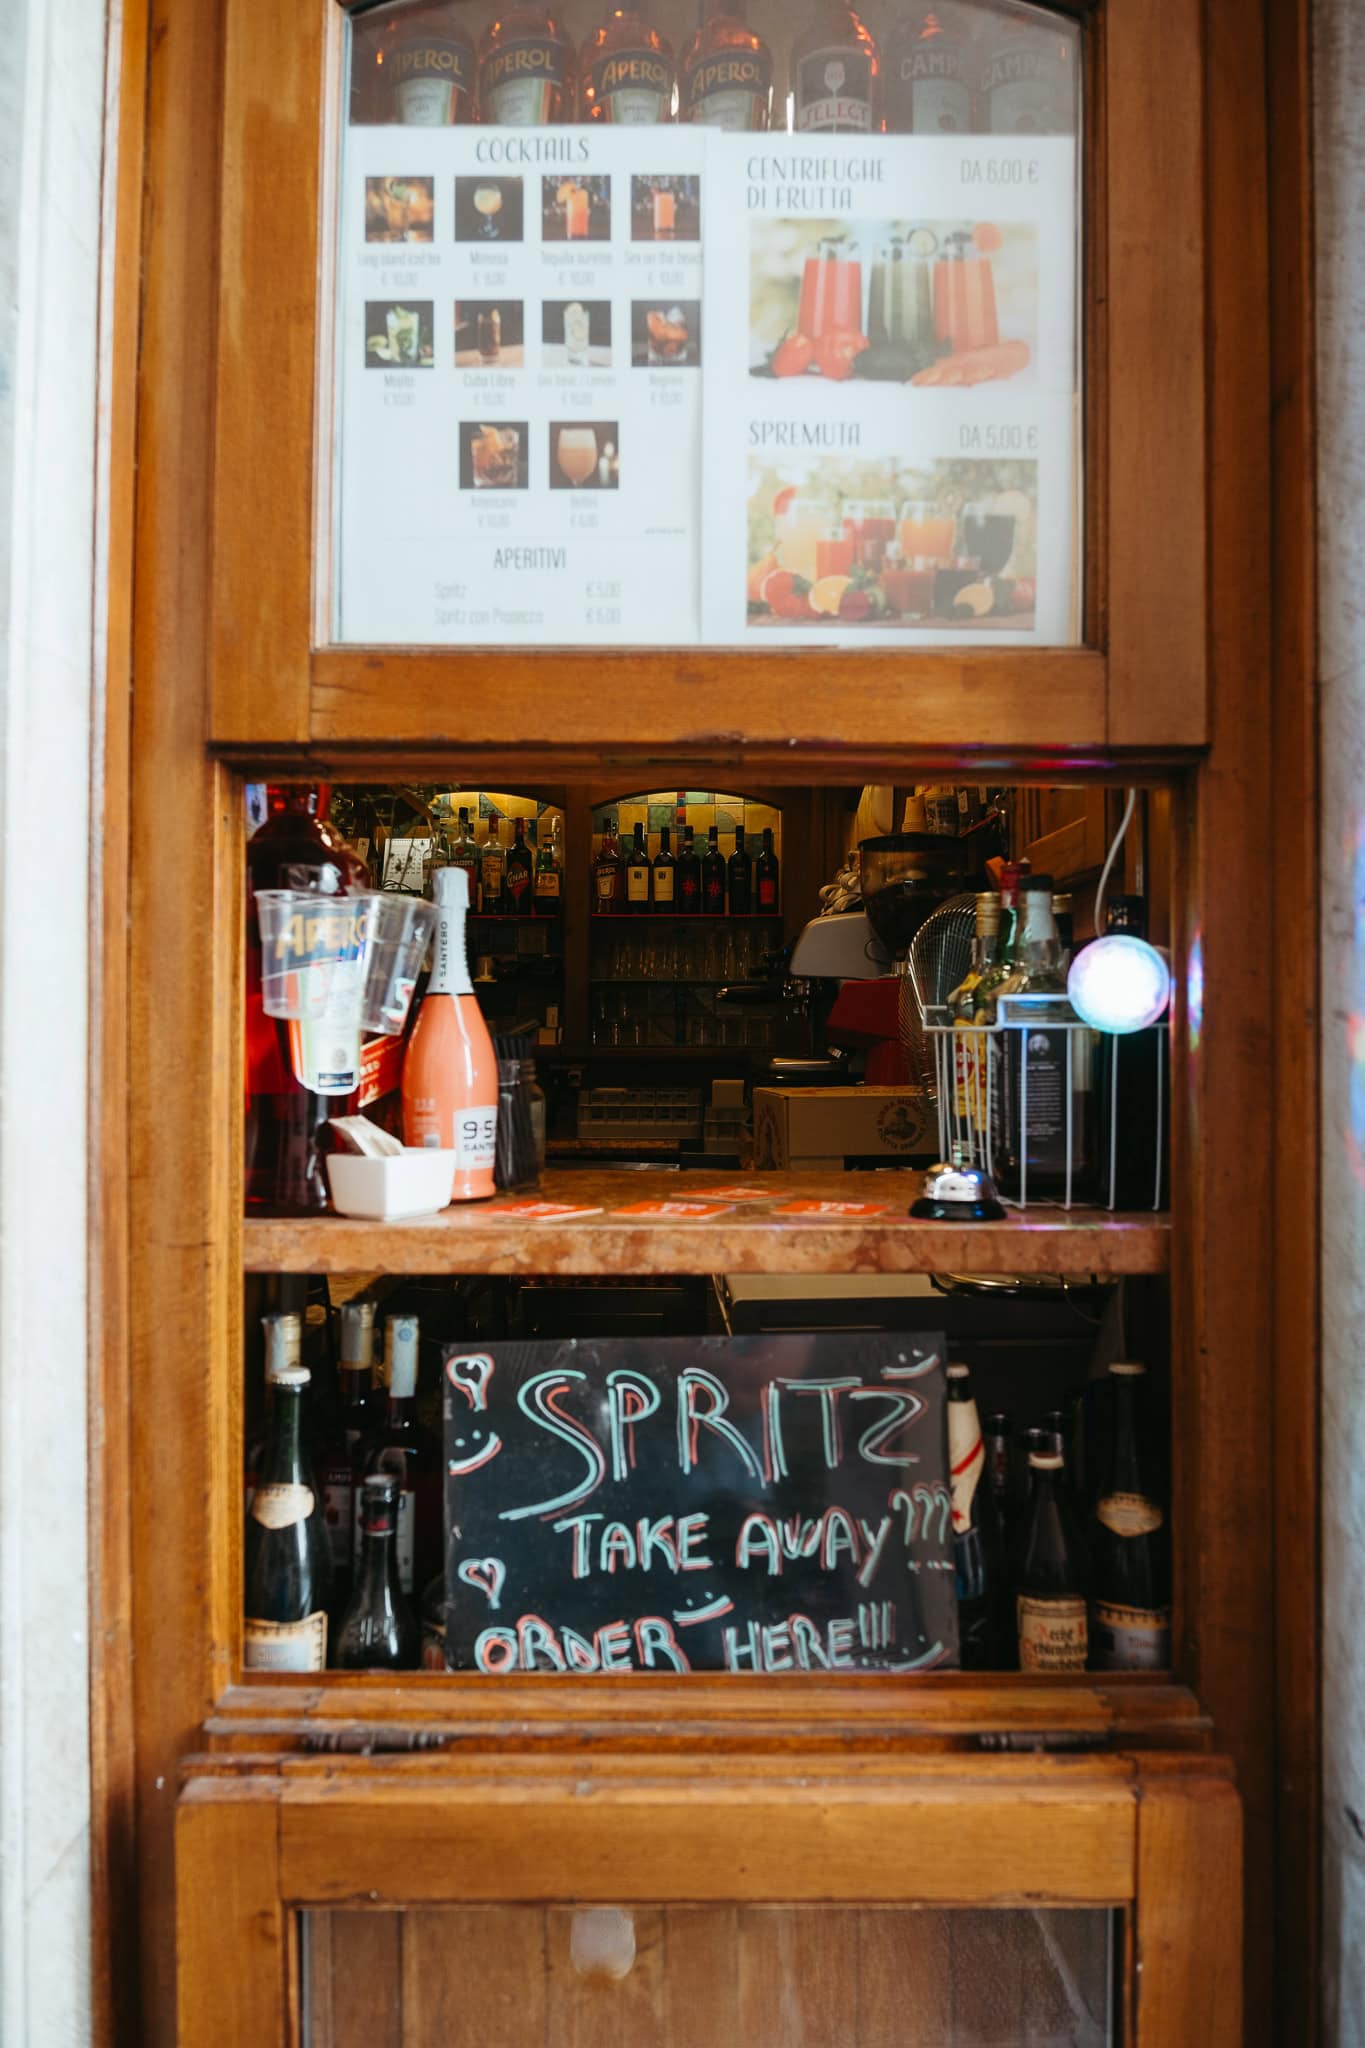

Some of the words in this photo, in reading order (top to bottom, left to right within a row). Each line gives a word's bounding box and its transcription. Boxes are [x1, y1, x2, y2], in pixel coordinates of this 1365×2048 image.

[476, 137, 590, 163] COCKTAILS
[747, 156, 886, 183] CENTRIFUGHE
[775, 186, 853, 209] FRUTTA
[749, 422, 861, 448] SPREMUTA
[493, 548, 567, 569] APERITIVI
[499, 1367, 929, 1521] SPRITZ
[554, 1512, 712, 1579] TAKE
[474, 1614, 692, 1673] ORDER
